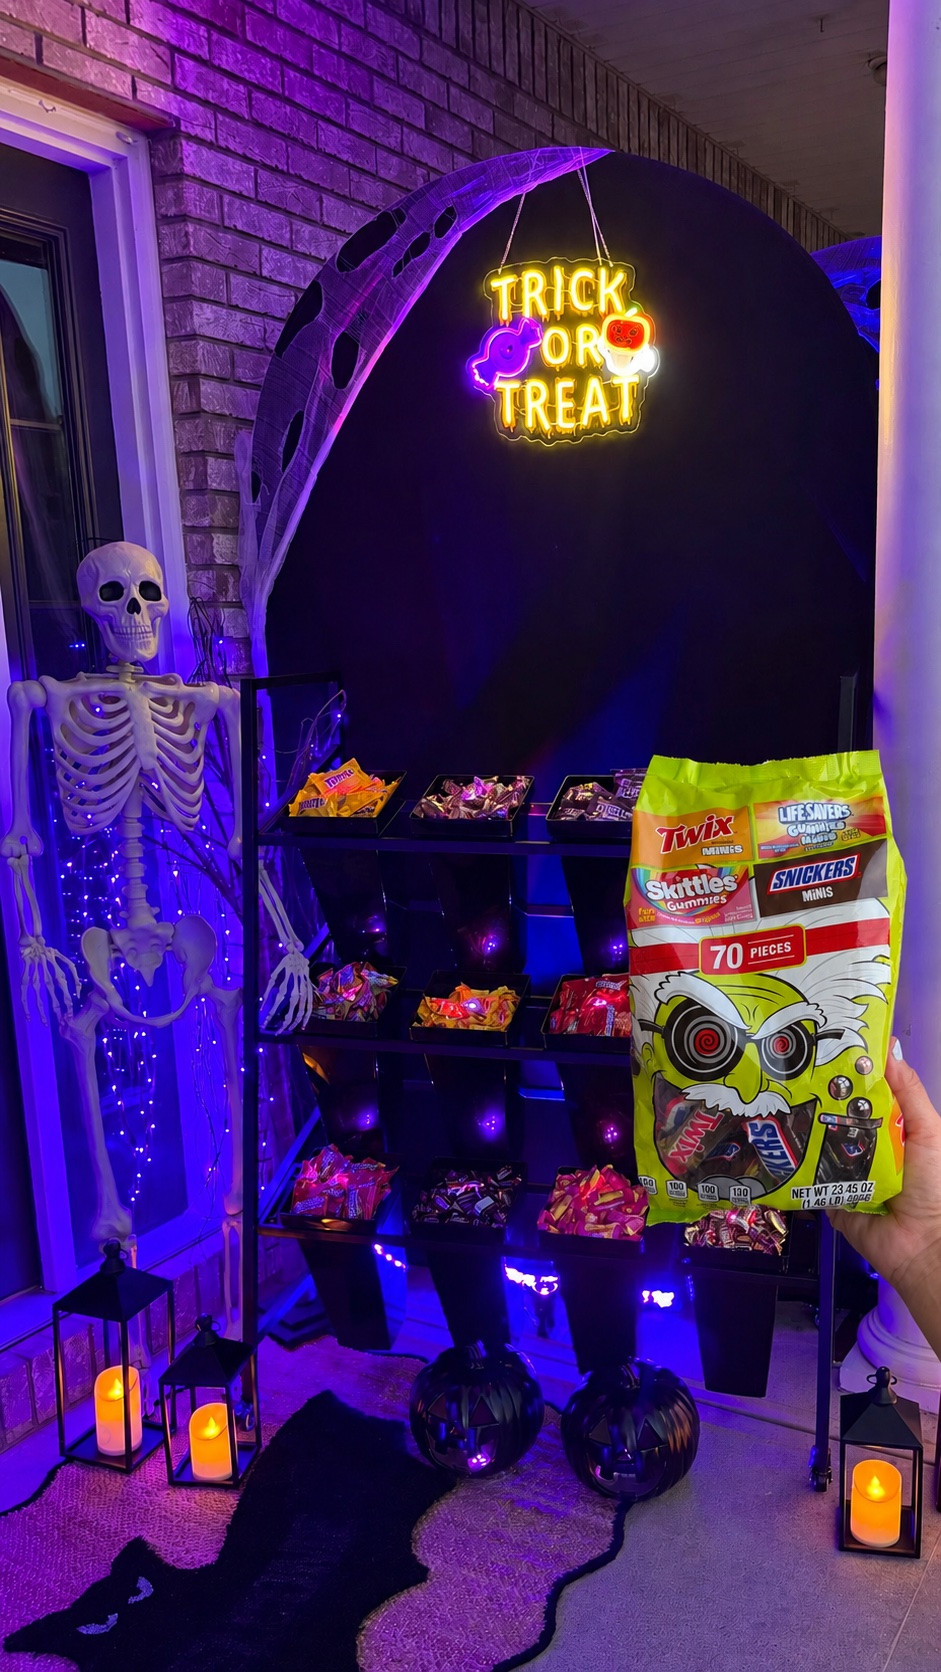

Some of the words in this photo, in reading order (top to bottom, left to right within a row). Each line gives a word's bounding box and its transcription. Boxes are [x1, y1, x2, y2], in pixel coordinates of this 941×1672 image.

[490, 265, 627, 326] TRICK
[541, 323, 605, 371] OR
[494, 373, 640, 438] TREAT
[772, 856, 856, 890] SNICKERS
[645, 874, 739, 901] Skittles
[666, 894, 728, 912] Gummies
[710, 942, 744, 970] 70
[750, 941, 792, 959] PIECES
[669, 1182, 684, 1191] 100
[701, 1185, 716, 1194] 100
[792, 1187, 812, 1199] NET
[813, 1185, 829, 1197] WT
[860, 1182, 874, 1193] OZ
